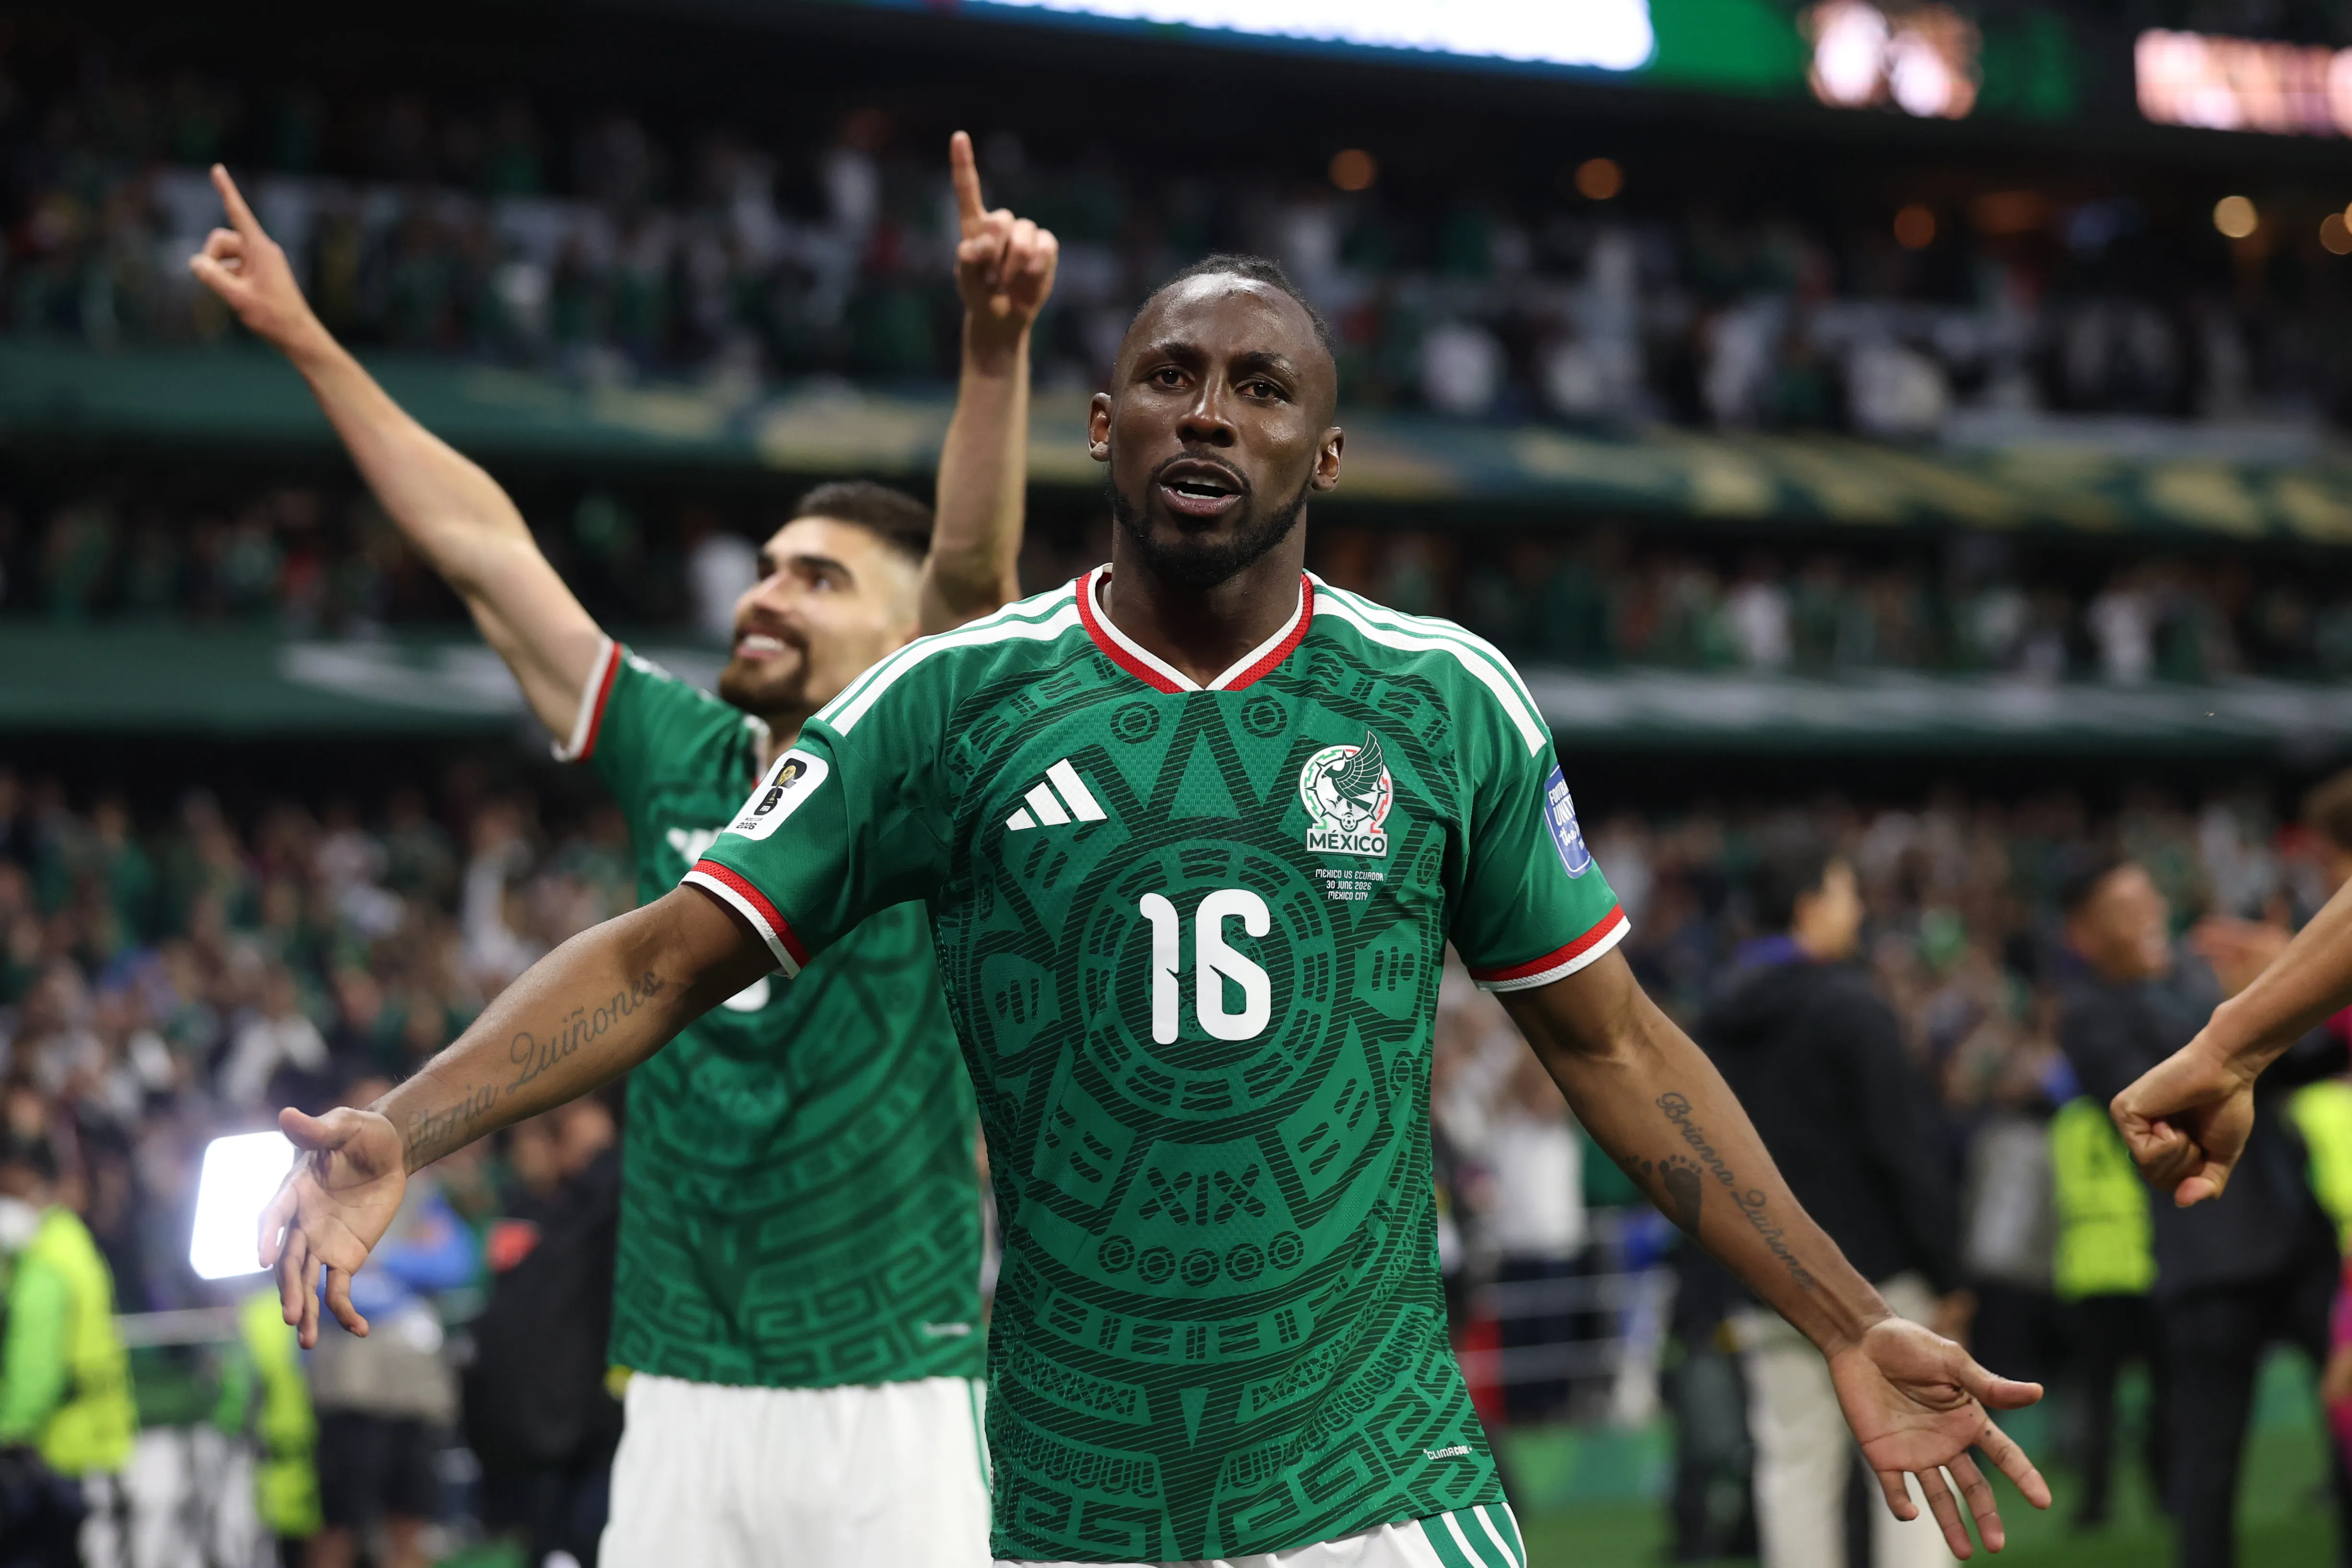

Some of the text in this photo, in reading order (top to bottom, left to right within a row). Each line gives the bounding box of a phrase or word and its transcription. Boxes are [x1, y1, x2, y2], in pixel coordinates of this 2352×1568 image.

[1548, 778, 1569, 806] FOOTBA
[1553, 794, 1575, 826] UNIT
[1310, 830, 1385, 853] MÉXICO
[1559, 826, 1577, 846] the
[1315, 869, 1342, 878] MEXICO
[1354, 871, 1383, 881] ECUADOR
[1326, 880, 1372, 890] 30 JUNE 2026
[1328, 891, 1368, 901] MEXICO CITY
[1140, 889, 1271, 1045] 16
[1656, 1092, 1735, 1187] Brianna
